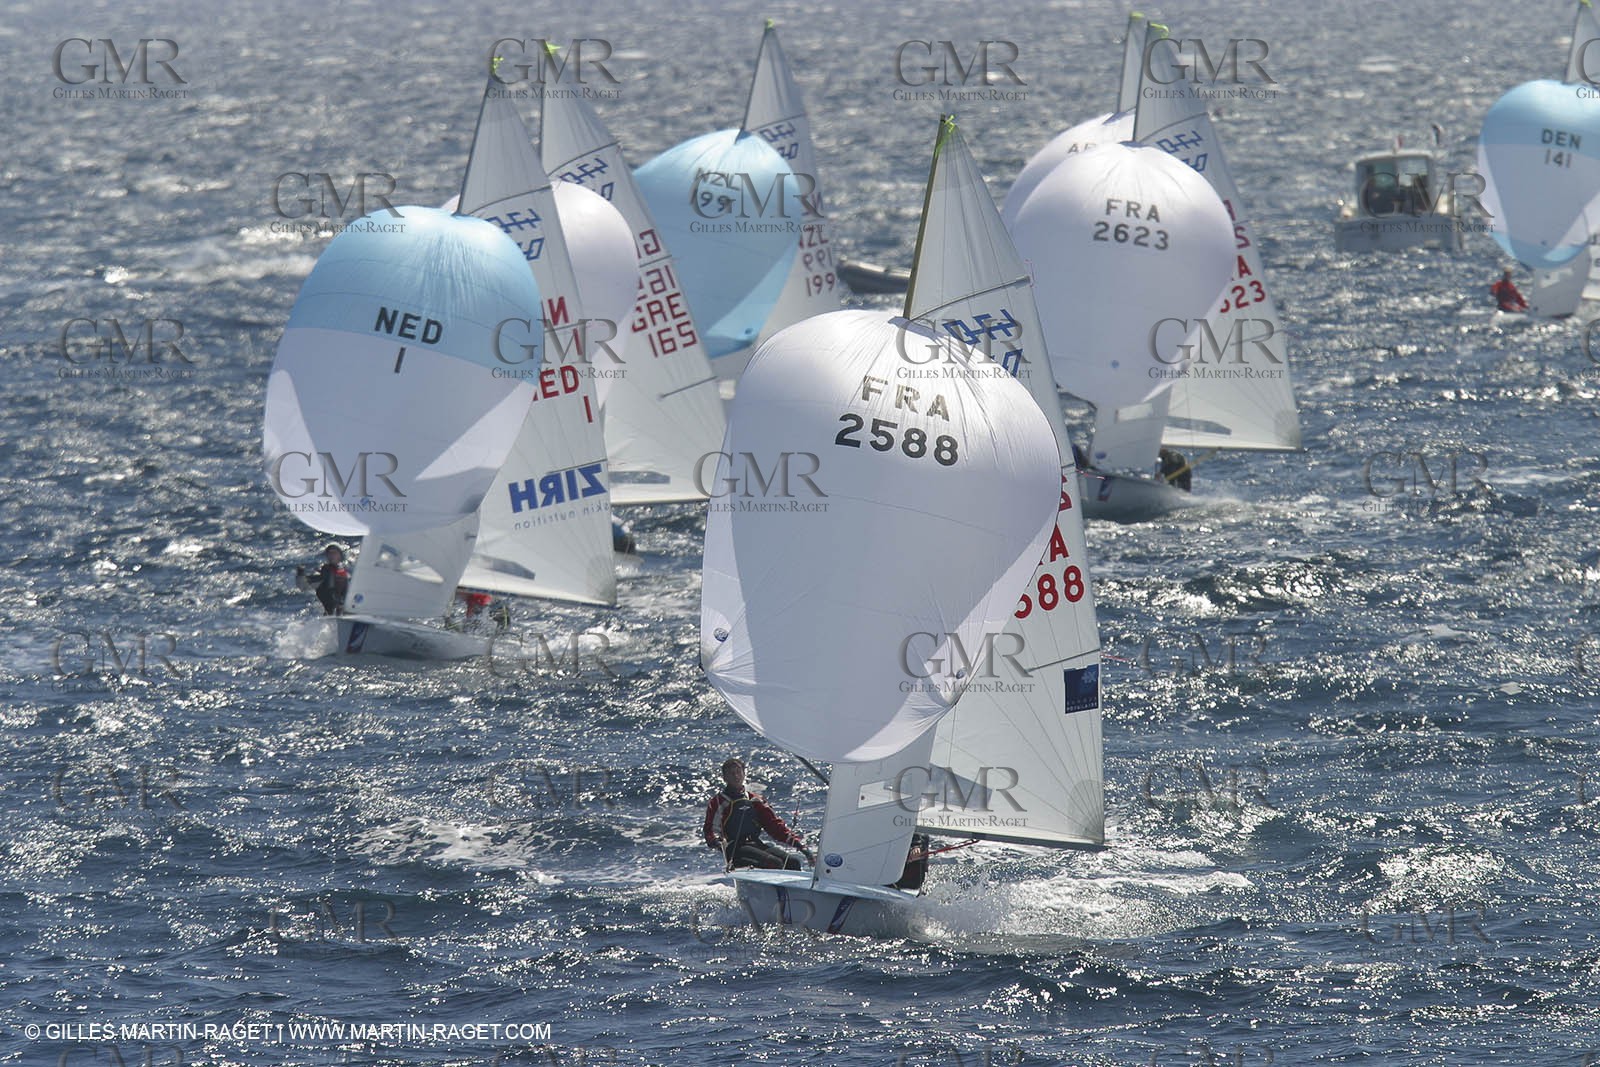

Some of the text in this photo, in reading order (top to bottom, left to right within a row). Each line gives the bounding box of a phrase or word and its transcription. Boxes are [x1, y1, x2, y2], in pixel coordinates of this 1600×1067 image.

[1541, 128, 1582, 151] DEN
[1545, 150, 1572, 168] 141
[1105, 199, 1160, 223] FRA
[1093, 221, 1168, 250] 2623
[806, 272, 836, 297] 199
[375, 307, 443, 346] NED
[648, 320, 697, 357] 165
[862, 375, 949, 422] FRA
[835, 413, 958, 466] 2588
